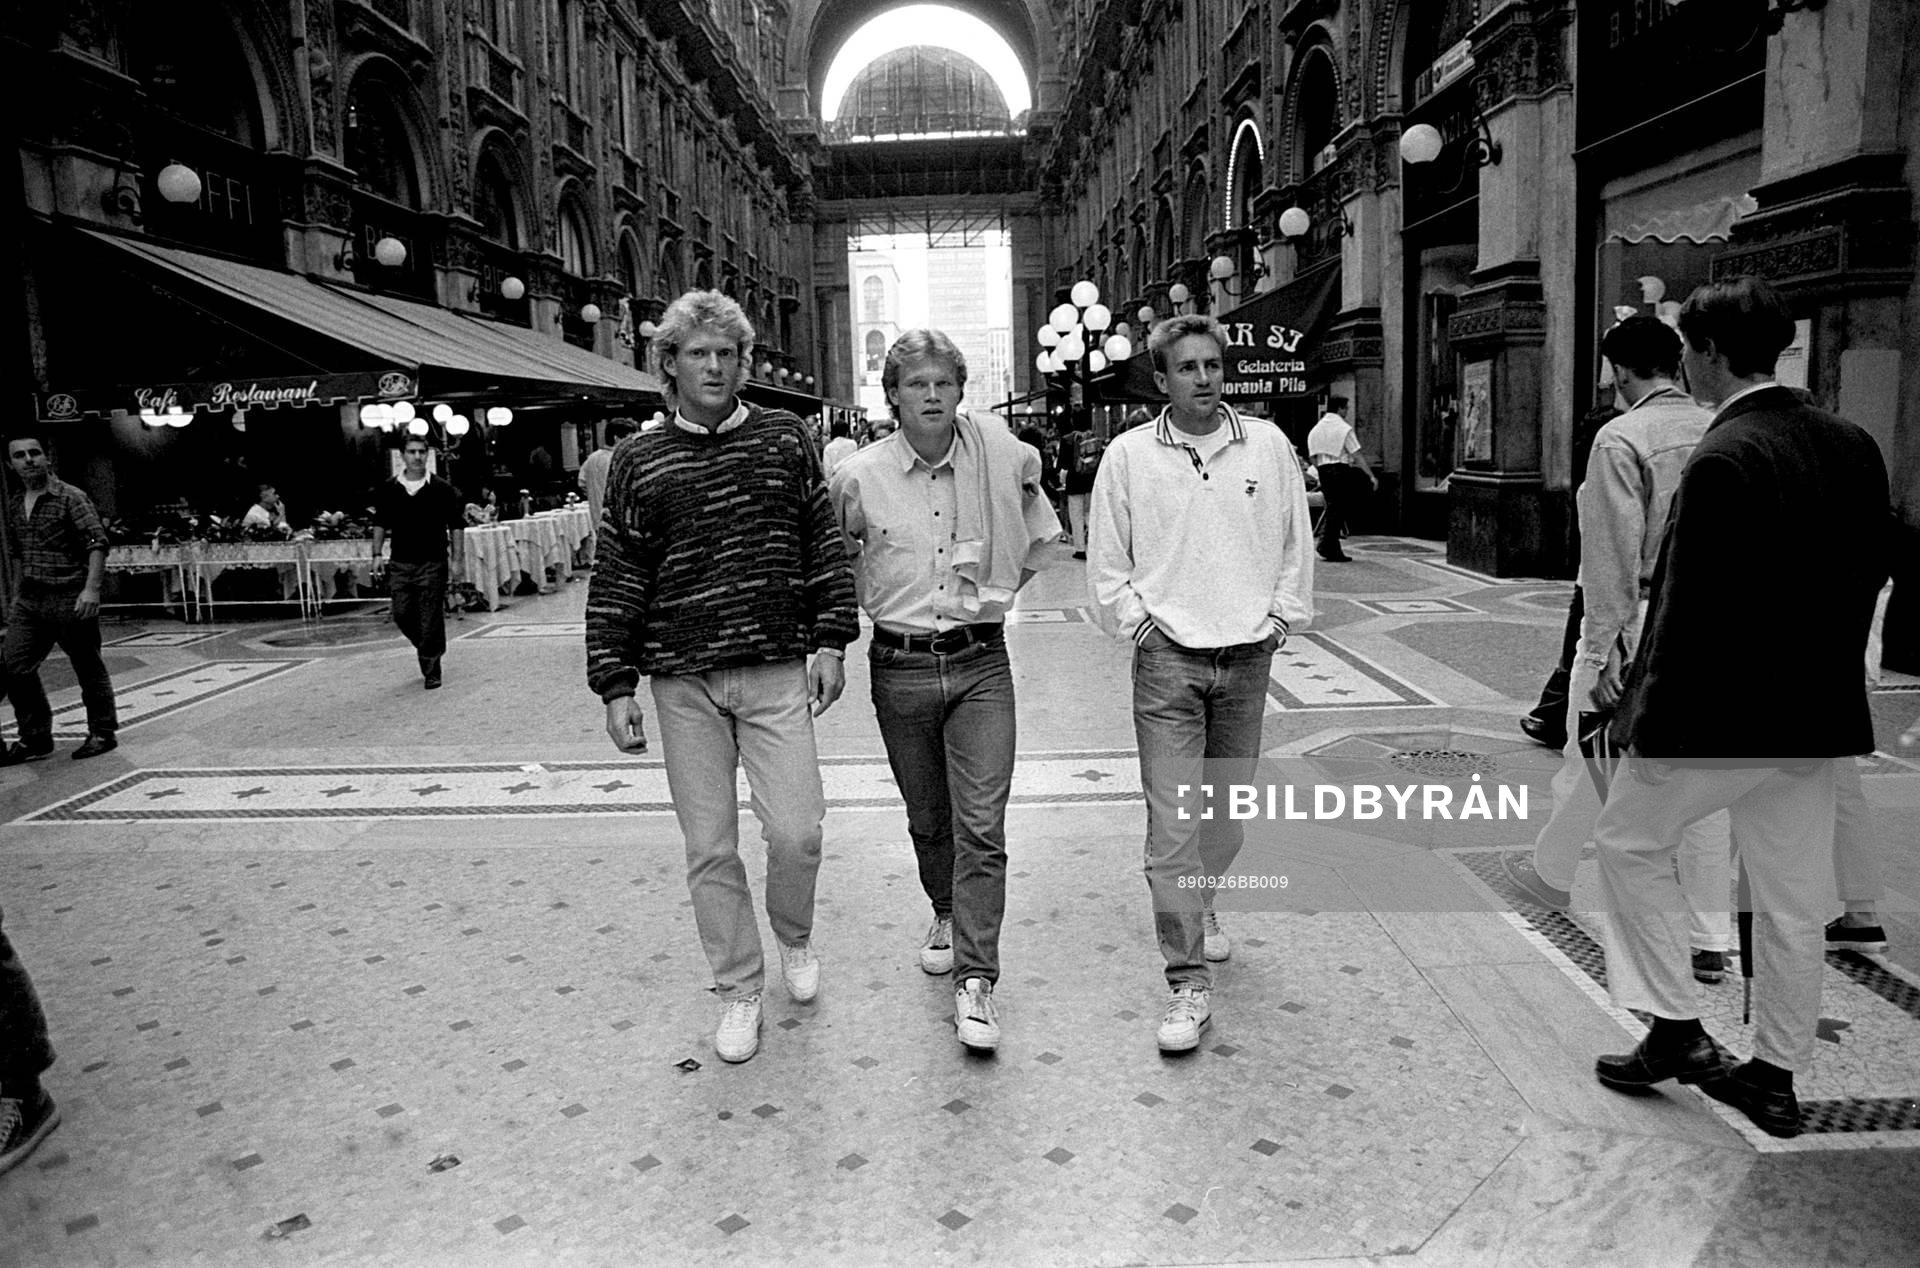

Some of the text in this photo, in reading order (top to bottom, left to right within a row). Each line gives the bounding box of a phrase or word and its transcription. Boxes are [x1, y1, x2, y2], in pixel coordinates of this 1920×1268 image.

[1237, 359, 1306, 374] Gelateria
[1221, 376, 1307, 395] oravia Pils
[134, 379, 319, 415] Café Restaurant
